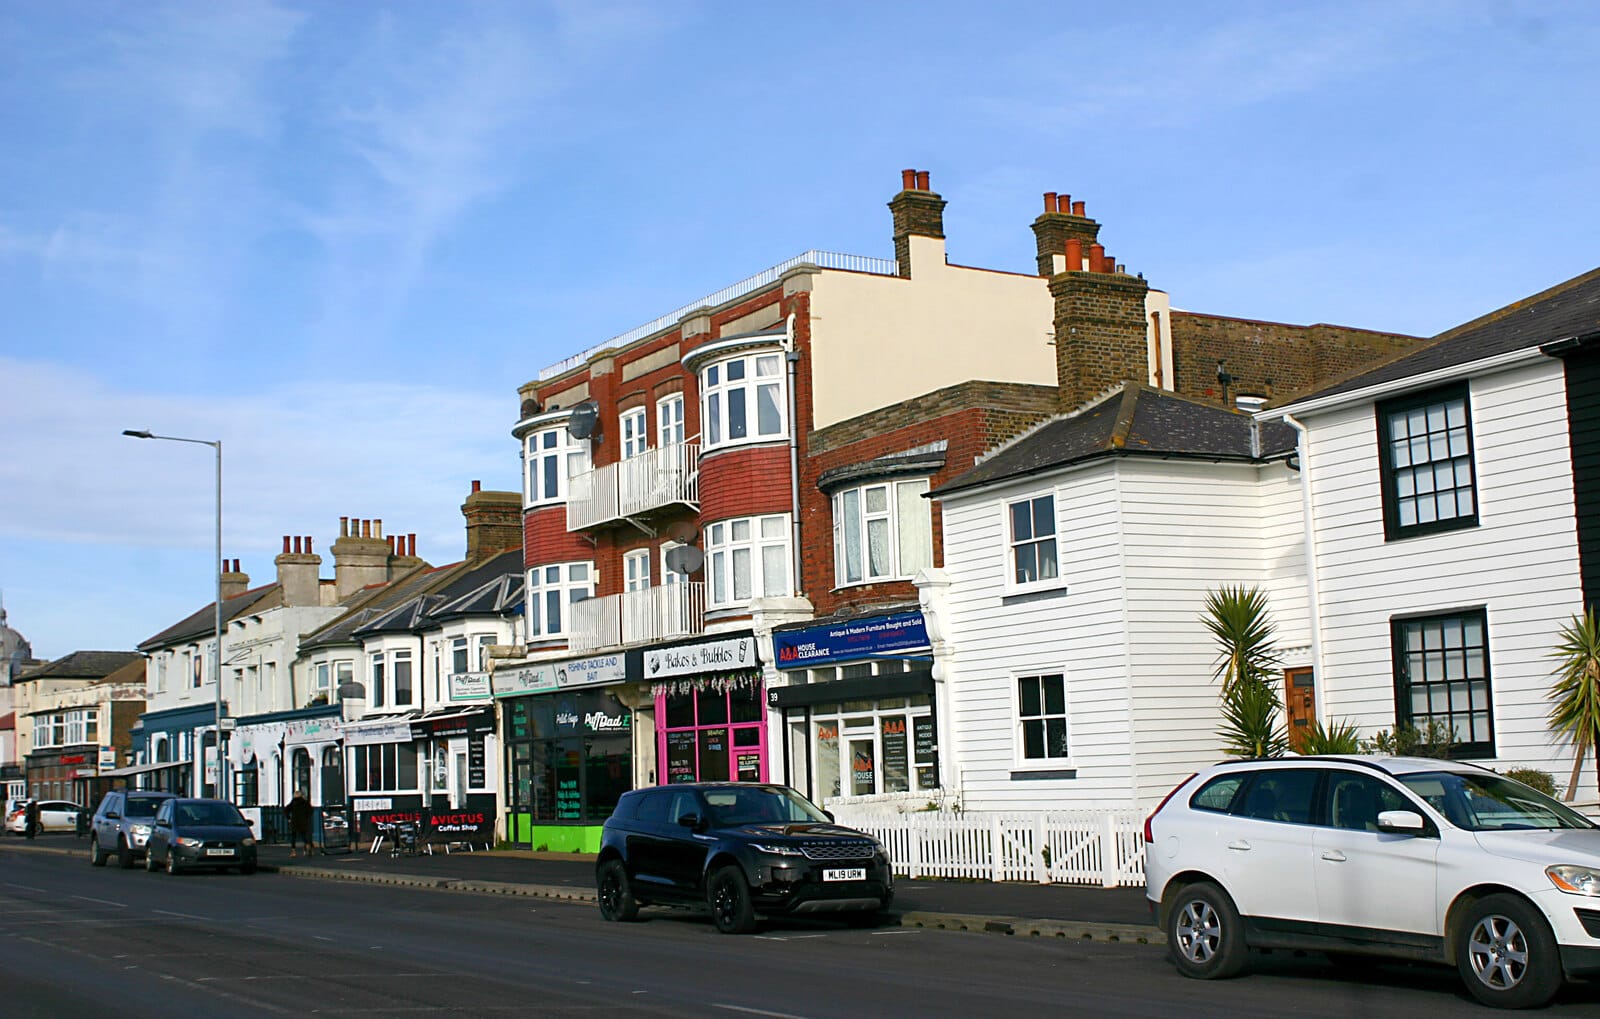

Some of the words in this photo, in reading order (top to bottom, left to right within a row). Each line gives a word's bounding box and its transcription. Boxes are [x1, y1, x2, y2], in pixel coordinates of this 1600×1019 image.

[866, 623, 885, 632] Furniture
[886, 620, 902, 631] Bought
[903, 619, 911, 628] and
[912, 618, 922, 626] Sold
[780, 646, 799, 662] A&A
[798, 643, 816, 653] HOUSE
[799, 648, 830, 660] CLEARANCE
[665, 652, 690, 669] Bakes
[692, 654, 698, 667] &
[700, 647, 733, 665] Bubbles
[568, 661, 587, 672] FISHING
[588, 658, 605, 669] TACKLE
[605, 657, 617, 667] AND
[587, 671, 598, 681] BAIT
[770, 693, 778, 702] 39
[818, 726, 839, 739] A&A
[884, 720, 905, 734] A&A
[430, 813, 485, 825] AVICTUS
[438, 824, 461, 833] Coffee
[461, 823, 478, 833] Shop
